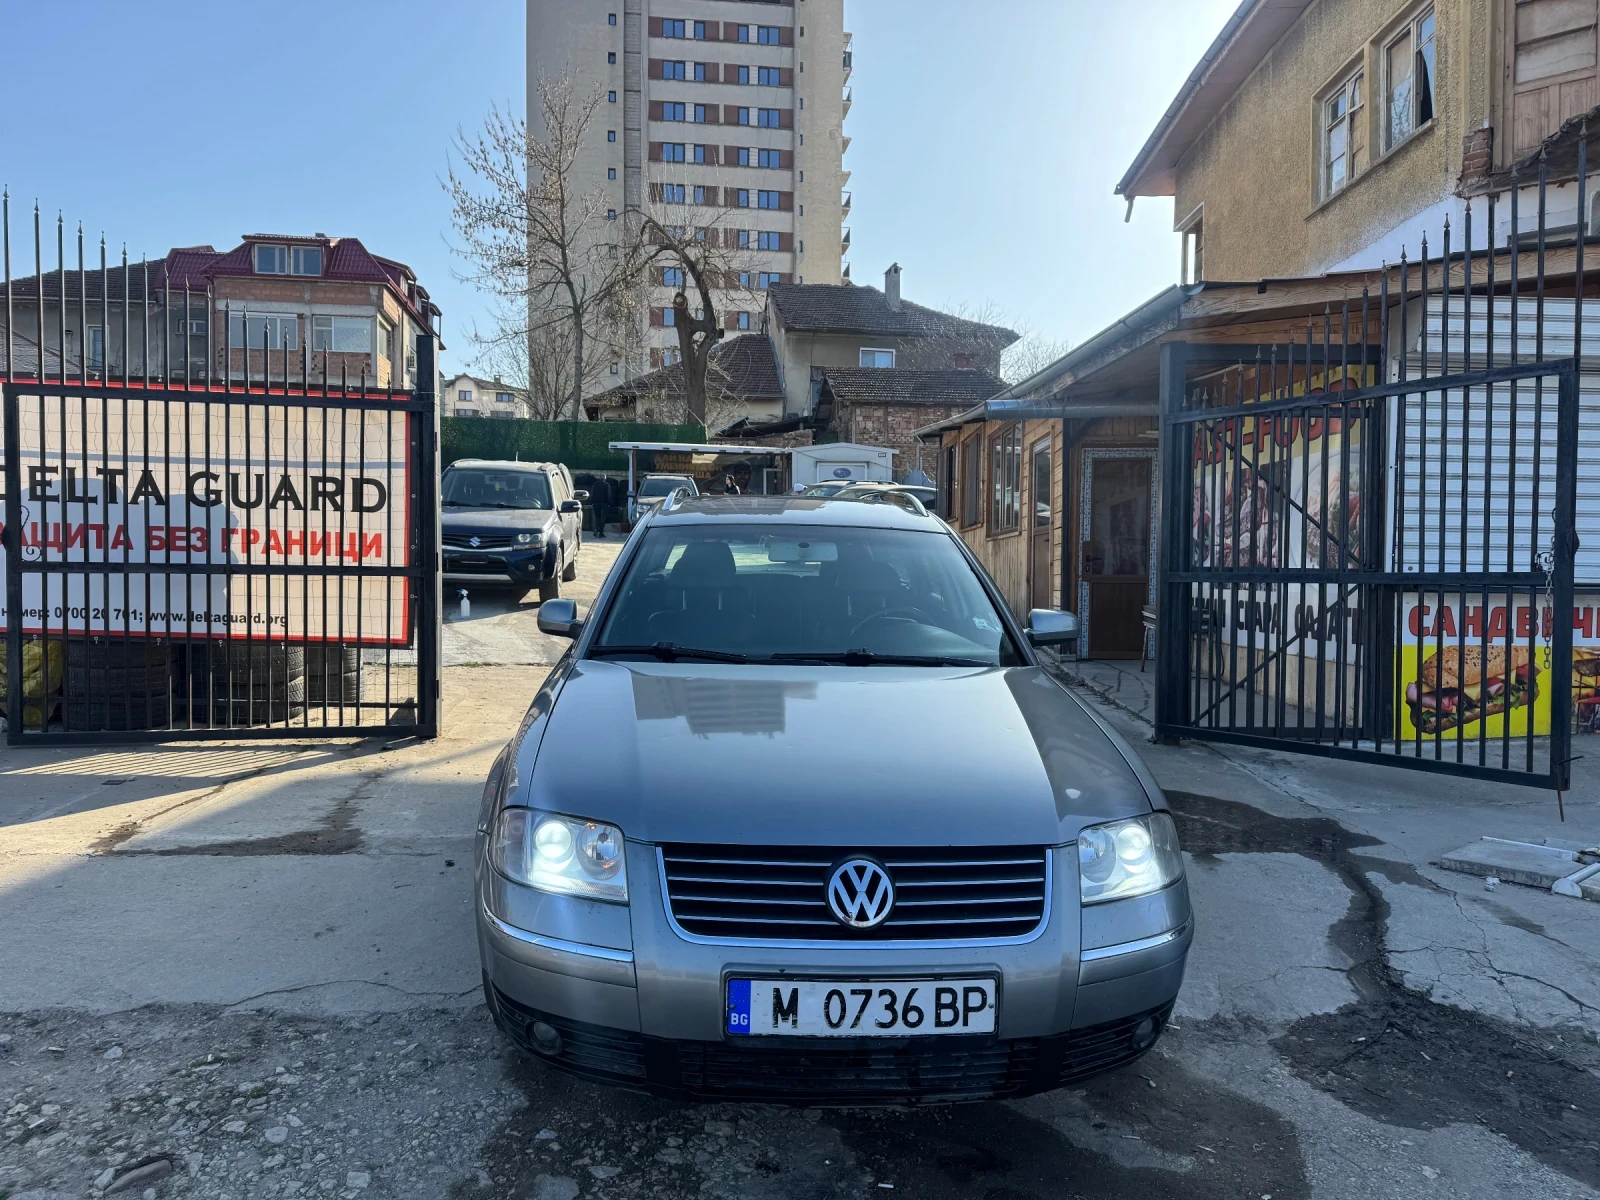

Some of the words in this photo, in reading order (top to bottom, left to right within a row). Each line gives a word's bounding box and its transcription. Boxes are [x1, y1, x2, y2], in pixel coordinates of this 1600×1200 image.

[1193, 376, 1359, 469] AST-FOOD
[0, 465, 166, 506] ELTA
[188, 470, 387, 513] GUARD
[0, 520, 134, 554] ЩИТА
[149, 525, 208, 553] БЕЗ
[220, 527, 383, 563] ГРАНИЦИ
[1, 607, 50, 621] нмер:
[54, 606, 88, 620] 000
[147, 610, 288, 628] www.elaguad.rg
[1408, 605, 1600, 644] САНДВЧ
[730, 1013, 748, 1026] BG
[772, 987, 799, 1029] M
[824, 987, 924, 1029] 0736
[934, 986, 988, 1028] BP
